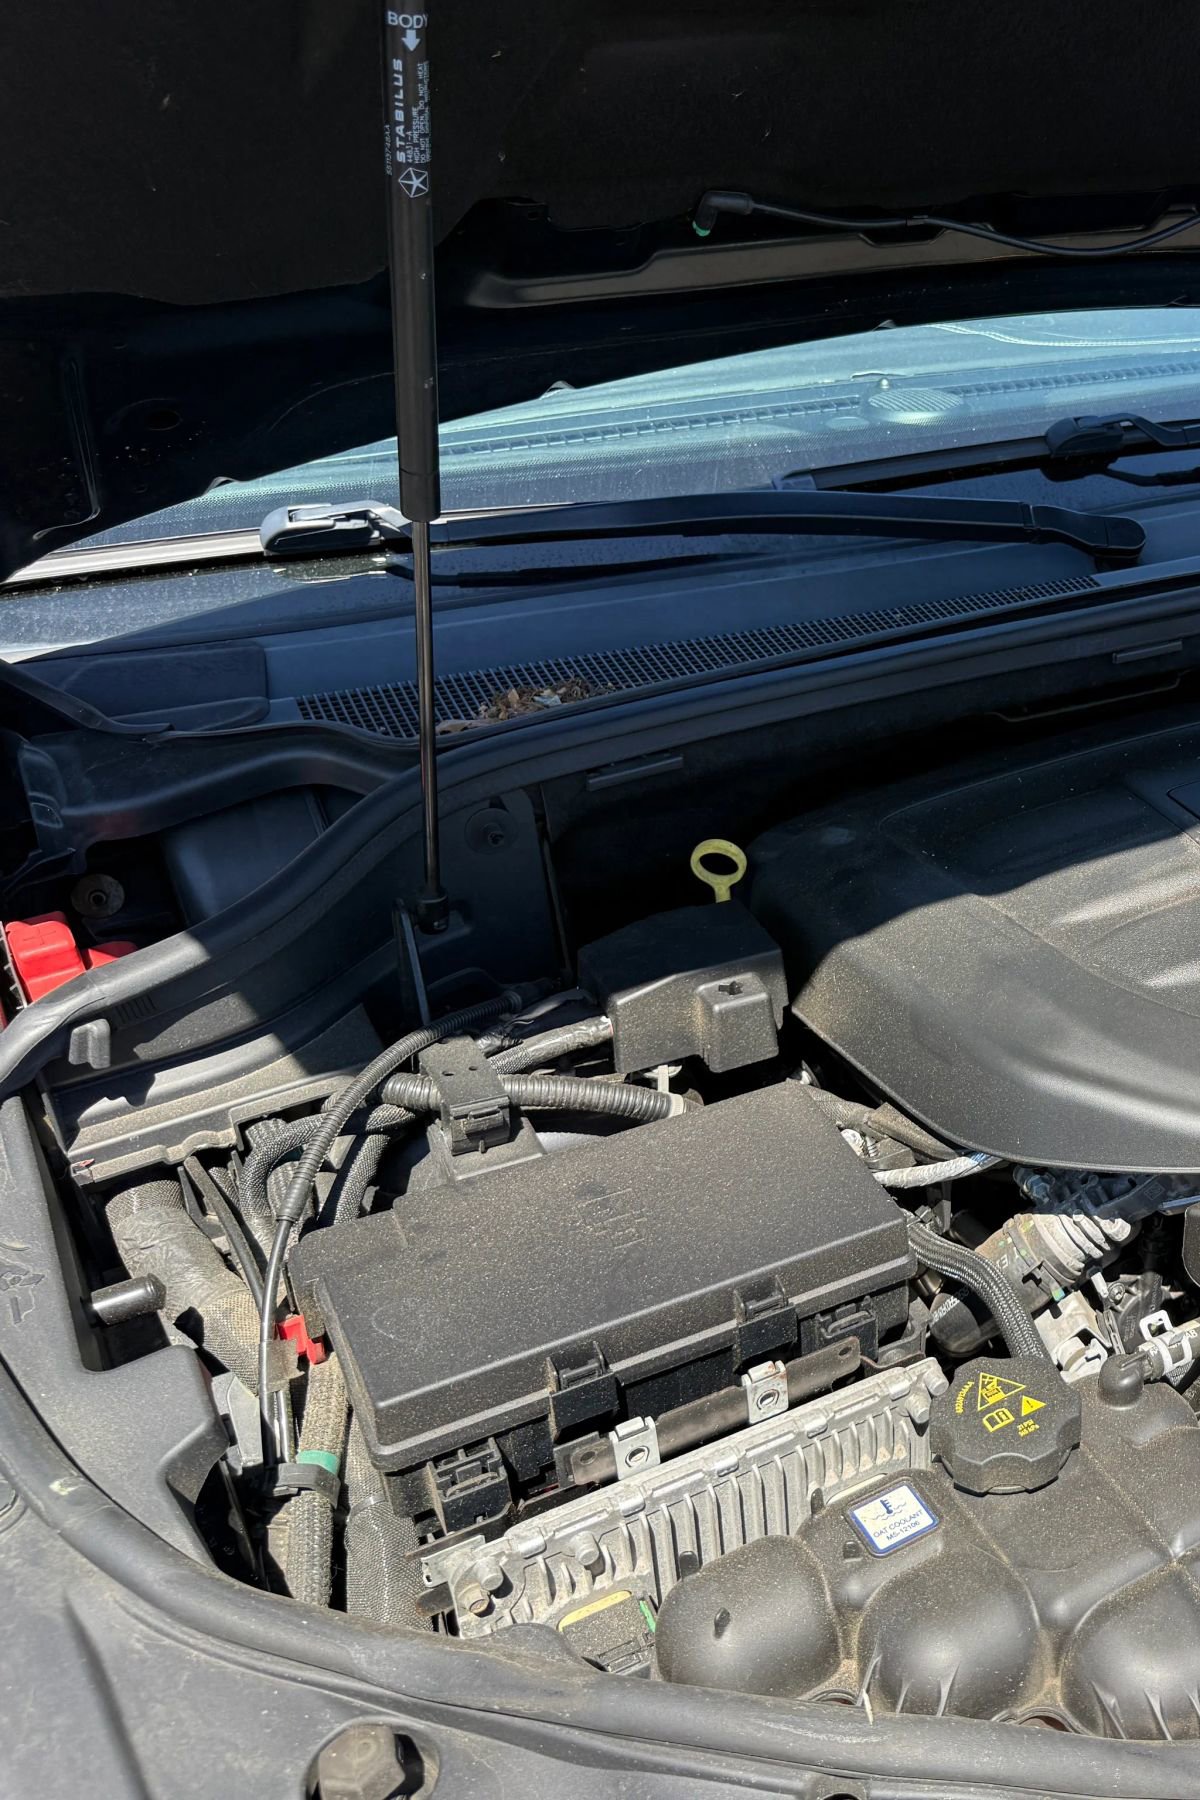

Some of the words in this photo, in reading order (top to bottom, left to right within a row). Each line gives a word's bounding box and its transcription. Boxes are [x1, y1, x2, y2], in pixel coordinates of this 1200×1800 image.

[387, 10, 428, 28] BODY
[393, 58, 405, 163] STABILUS
[412, 106, 420, 143] PRESSURE
[874, 1527, 888, 1538] OAT
[889, 1509, 922, 1530] COOLANT
